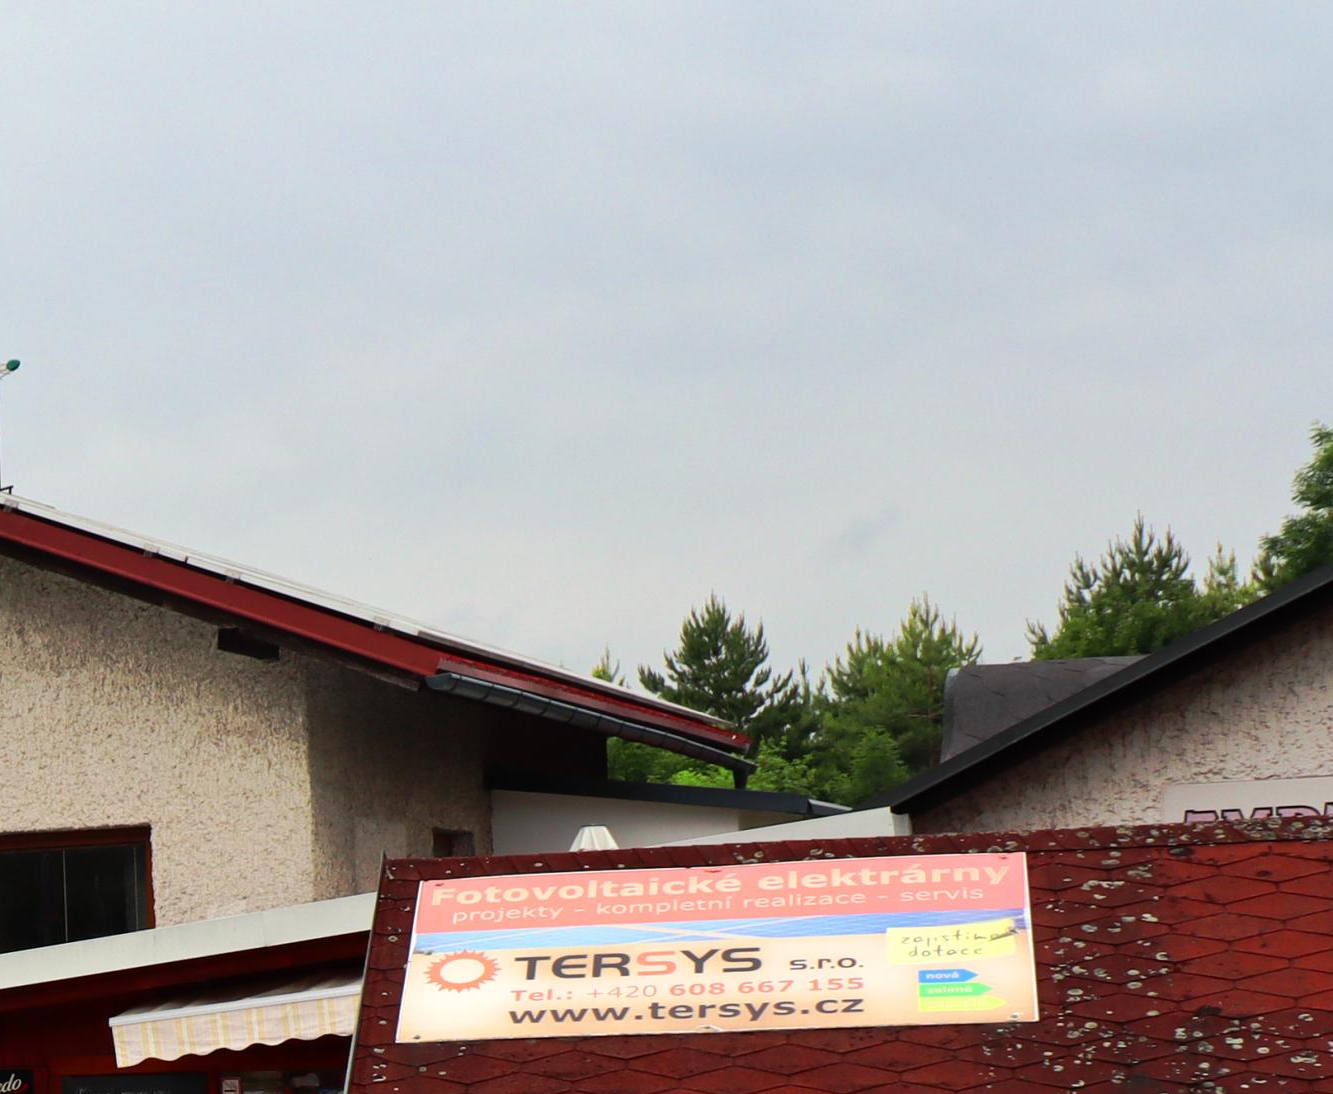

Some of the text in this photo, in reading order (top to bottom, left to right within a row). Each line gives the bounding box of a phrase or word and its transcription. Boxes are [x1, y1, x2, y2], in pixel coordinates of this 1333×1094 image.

[430, 864, 1010, 906] Fotovoltaické elektrárny
[452, 906, 564, 925] projekty
[596, 896, 733, 915] kompletní
[743, 893, 866, 909] realizace
[900, 886, 984, 902] servis
[514, 947, 864, 980] TERSYS s.r.o.
[909, 945, 983, 957] dotace
[926, 971, 960, 980] nová
[510, 977, 864, 1002] Tel.: +420 608 667 155
[509, 998, 864, 1025] www.tersys.cz
